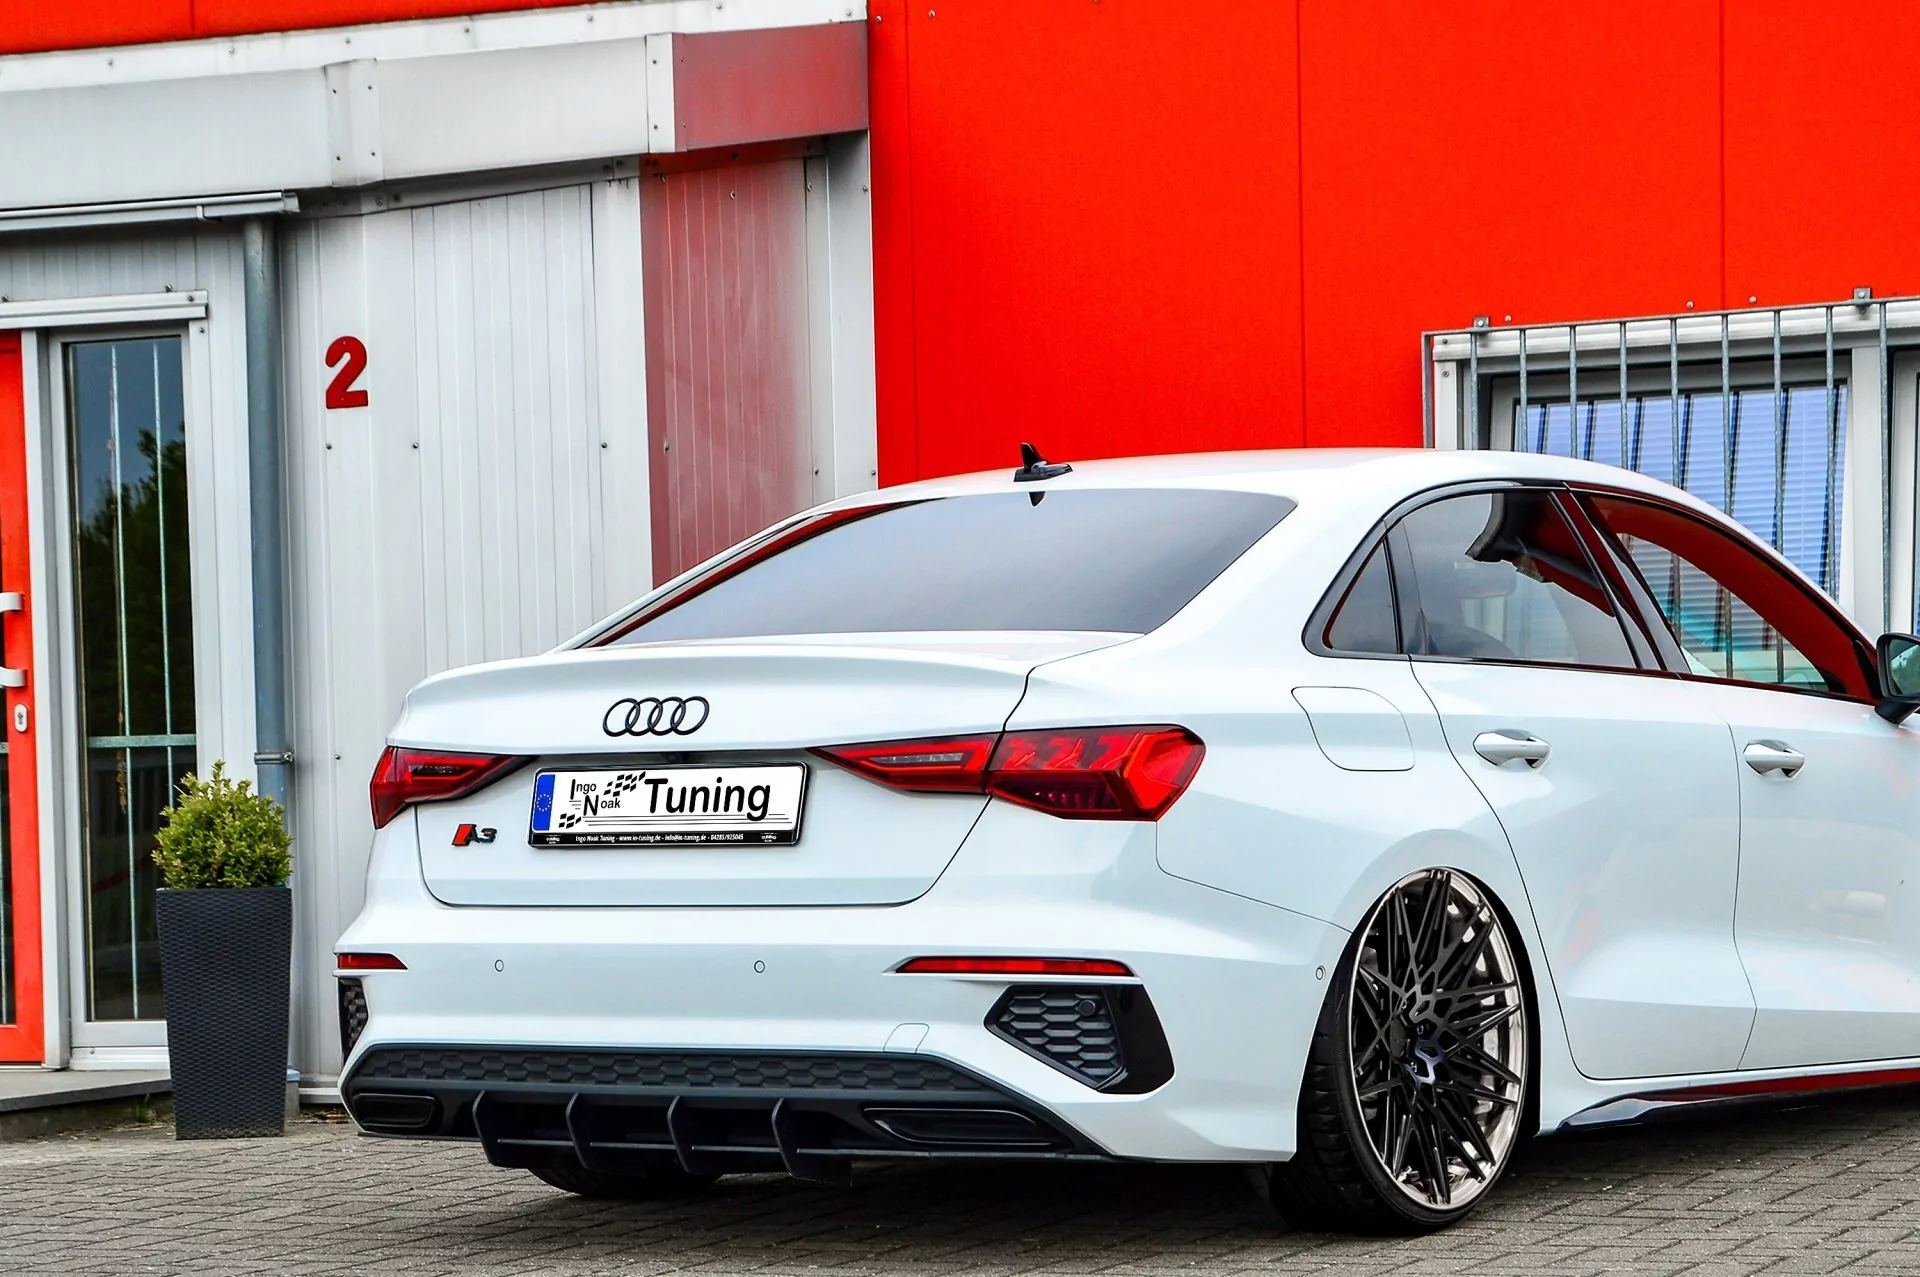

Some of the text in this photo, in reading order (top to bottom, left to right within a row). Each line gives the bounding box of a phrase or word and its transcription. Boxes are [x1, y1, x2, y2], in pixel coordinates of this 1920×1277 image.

[325, 336, 369, 409] 2
[570, 778, 597, 800] Ingo
[644, 777, 771, 822] Tuning
[583, 794, 621, 816] Noak
[451, 823, 498, 847] A3
[576, 835, 586, 843] Ingo
[600, 835, 615, 843] Tuning
